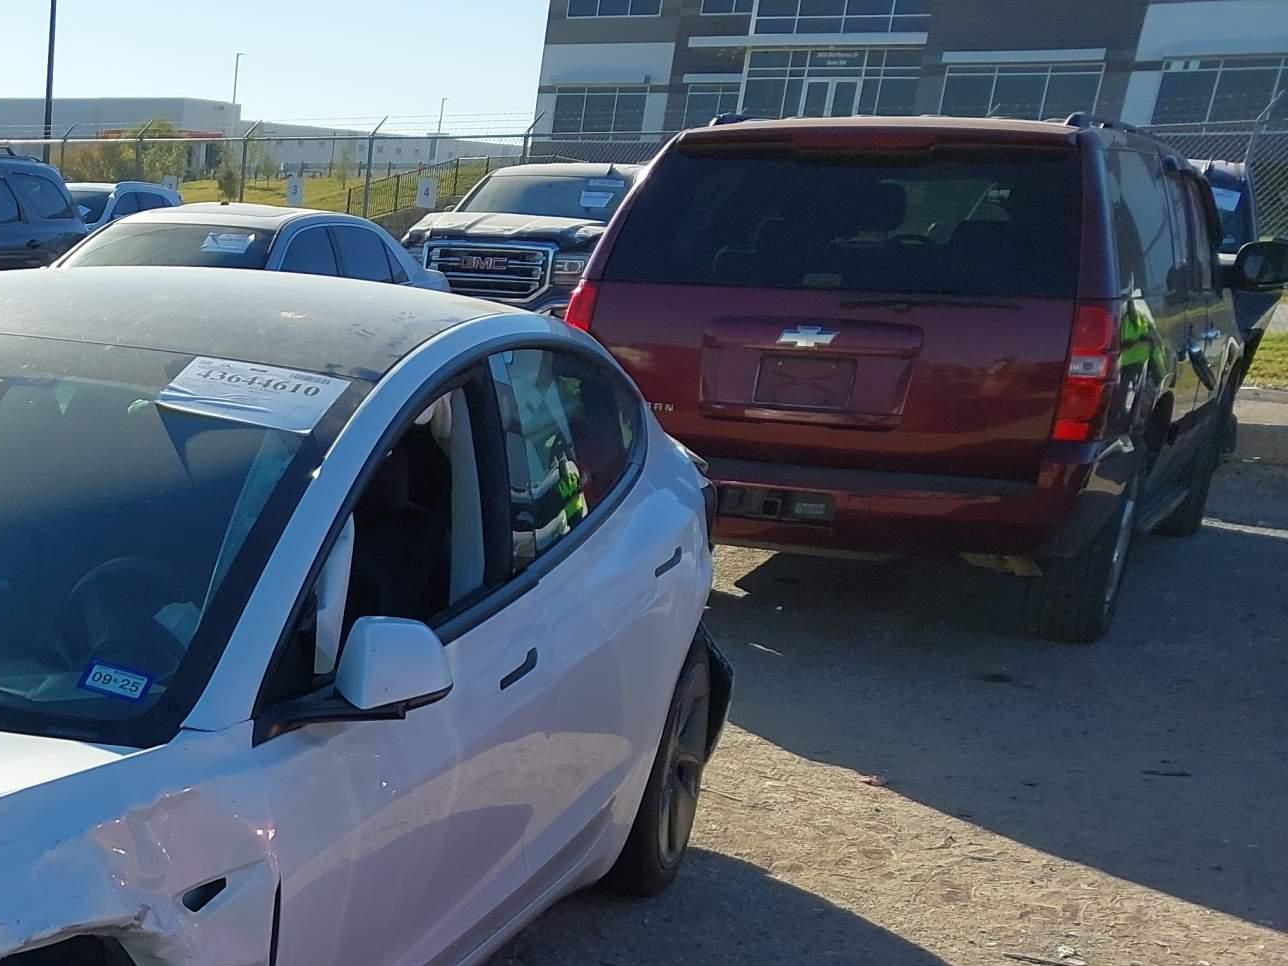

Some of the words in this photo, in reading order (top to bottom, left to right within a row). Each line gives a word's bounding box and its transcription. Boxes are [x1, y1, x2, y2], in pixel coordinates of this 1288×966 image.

[460, 256, 508, 270] GMC
[196, 368, 322, 397] 43644610
[92, 671, 112, 685] 09
[118, 678, 141, 693] 25
